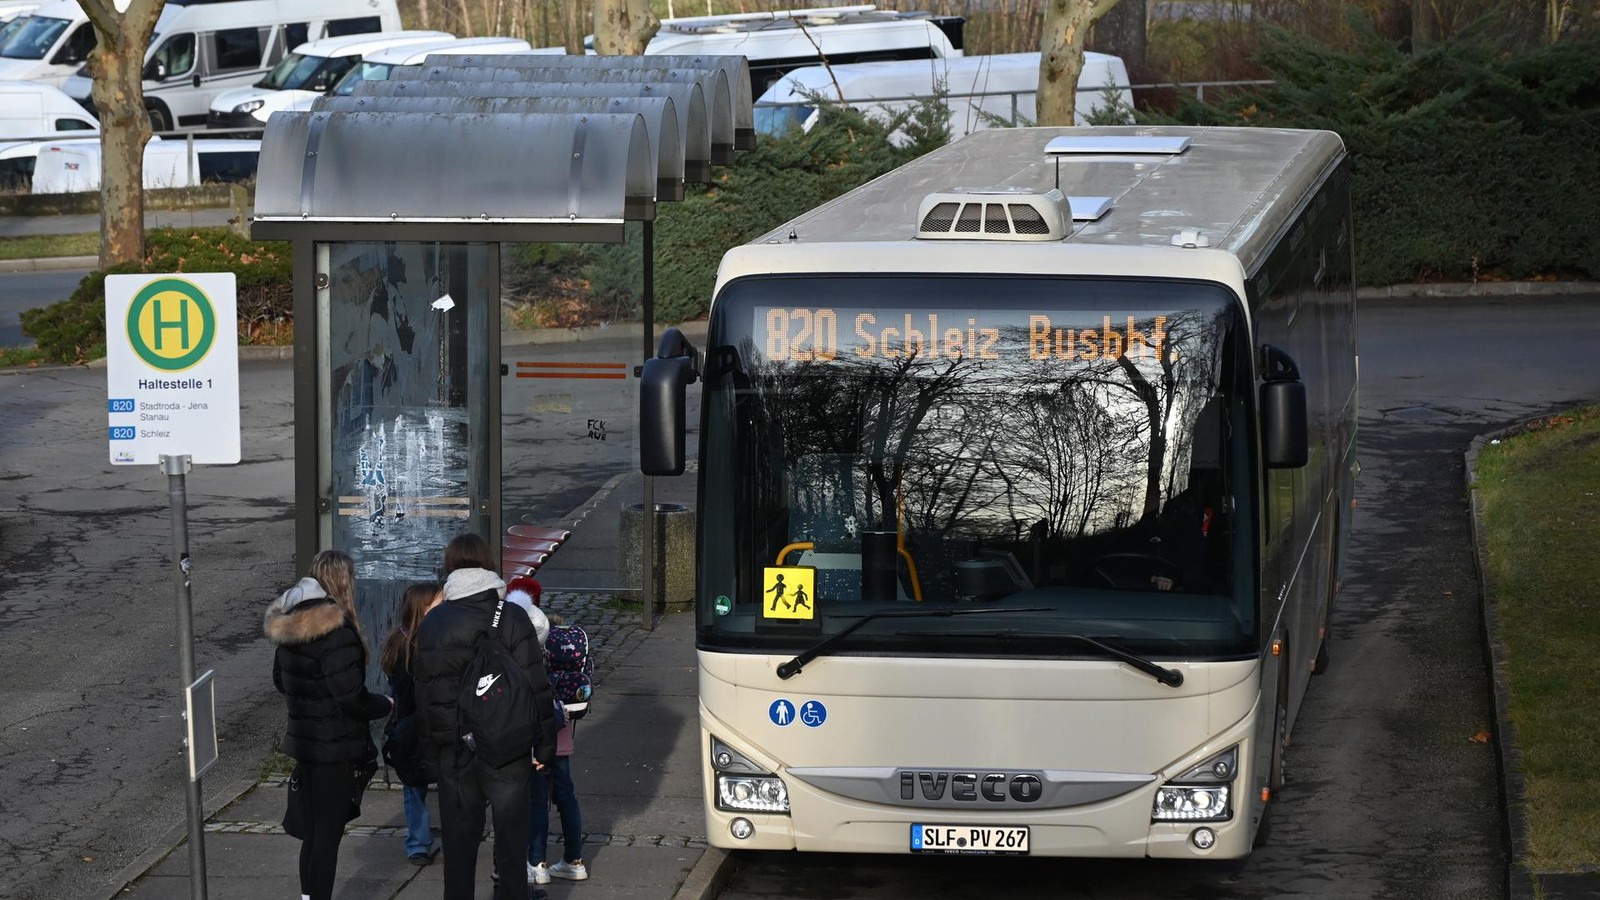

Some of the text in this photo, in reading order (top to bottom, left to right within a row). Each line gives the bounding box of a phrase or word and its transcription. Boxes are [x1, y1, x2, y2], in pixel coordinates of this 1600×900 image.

[153, 299, 189, 350] H
[766, 308, 837, 361] 820
[855, 313, 999, 360] Schleiz
[138, 378, 213, 390] Haltestelle 1
[112, 400, 133, 411] 820
[139, 402, 181, 411] Stadtroda
[187, 402, 208, 410] Jena
[139, 413, 169, 421] Stanau
[587, 419, 606, 431] FCK
[113, 428, 171, 439] 820 Schleiz
[491, 610, 502, 628] NIKE
[901, 771, 1043, 803] IVECO
[924, 828, 1027, 849] SLF PV 267
